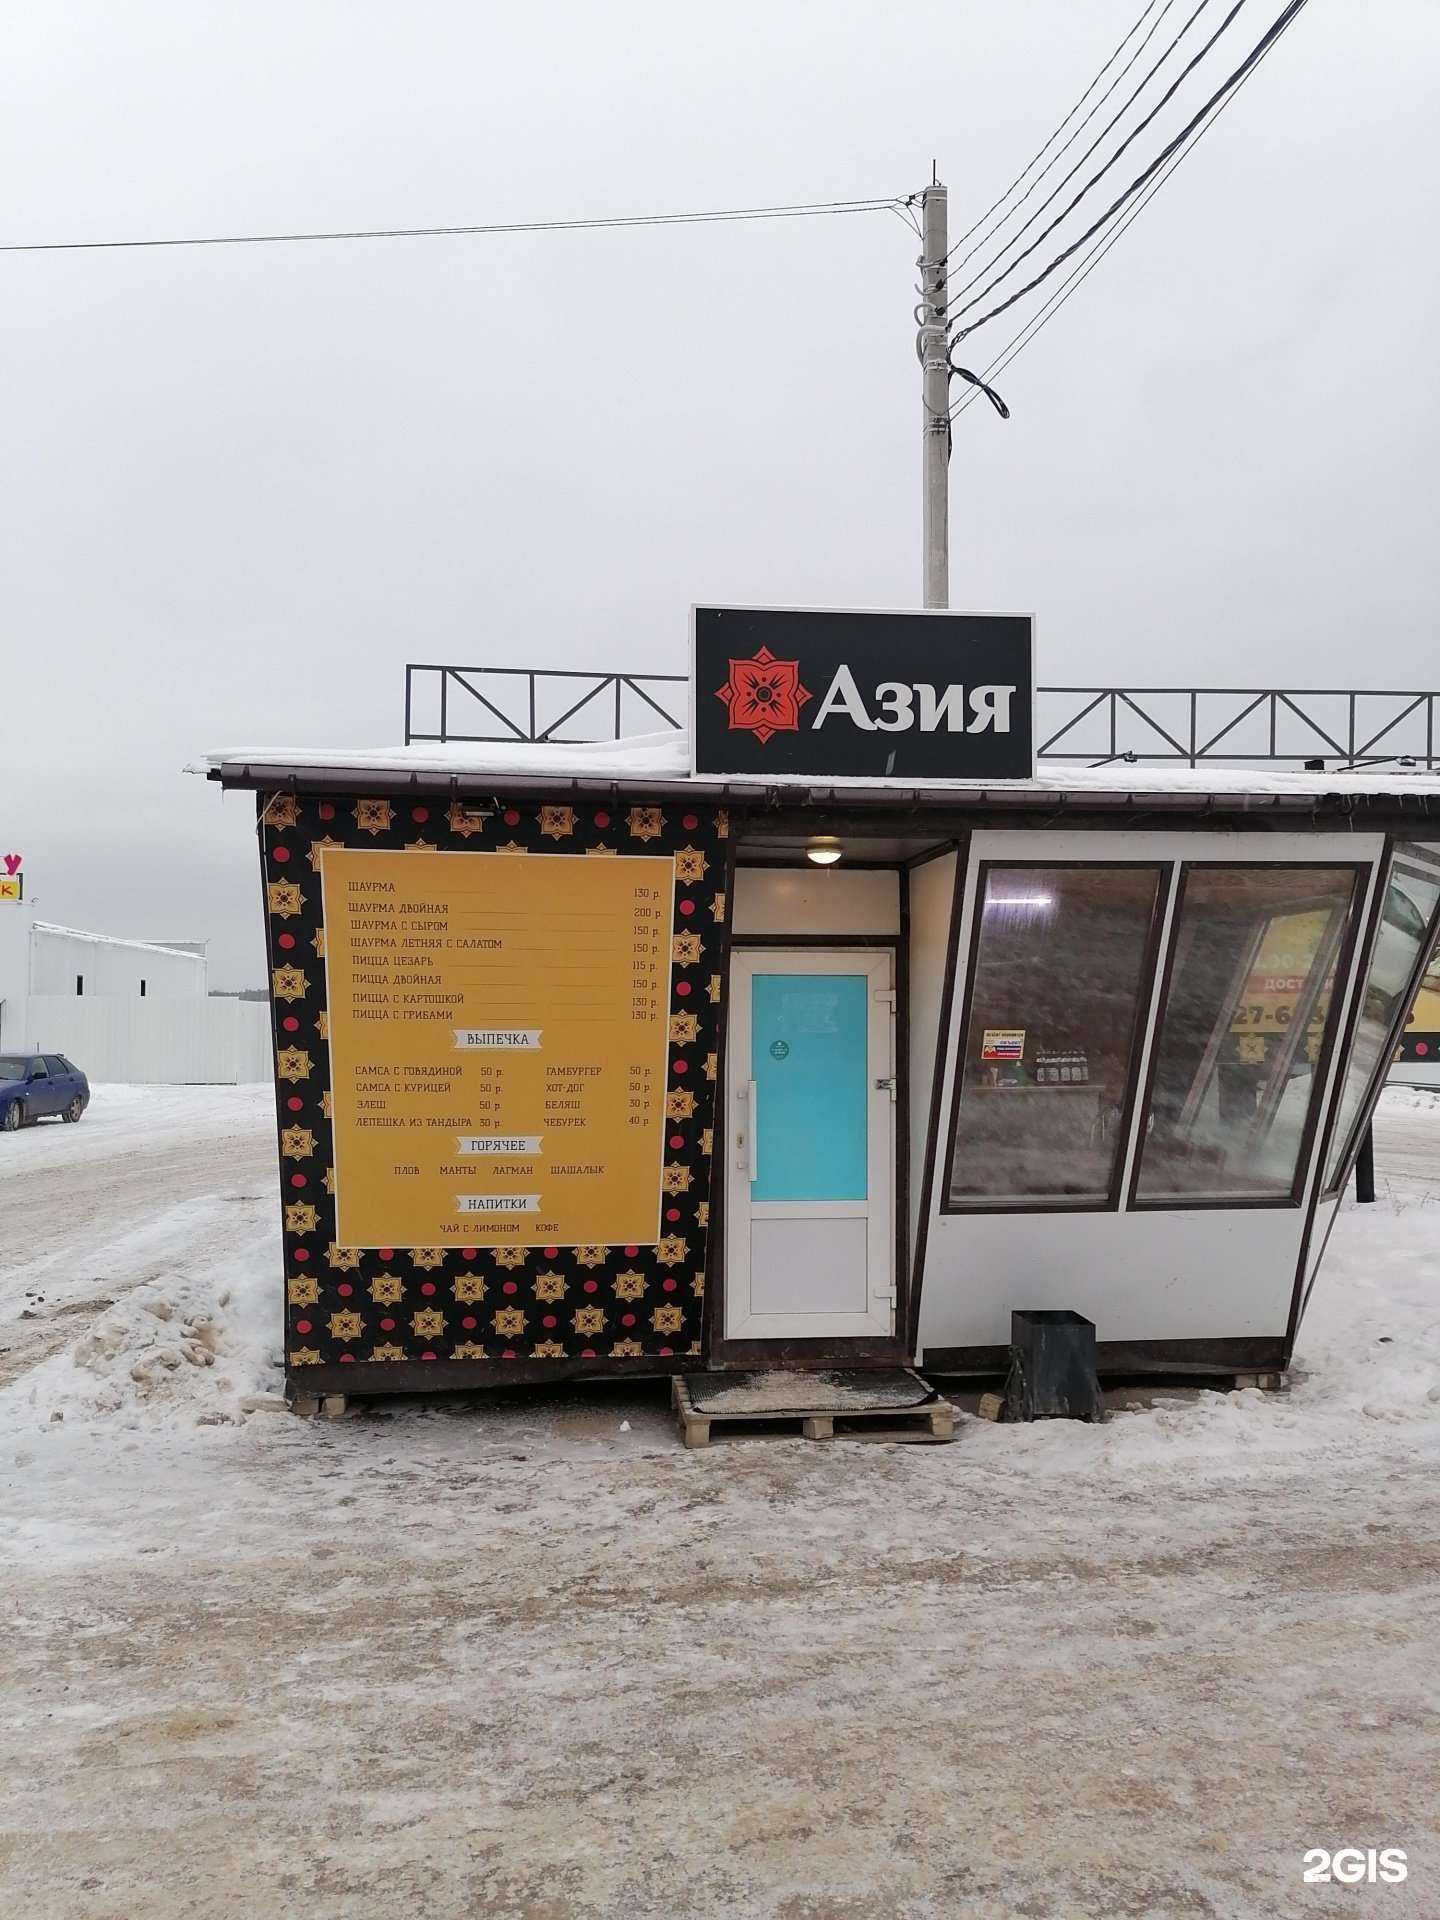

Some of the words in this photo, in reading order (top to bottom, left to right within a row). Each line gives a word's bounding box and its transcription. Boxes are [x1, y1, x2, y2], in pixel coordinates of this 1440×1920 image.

[811, 664, 1017, 734] Азия
[348, 881, 396, 893] ШАУРМА
[348, 902, 395, 913] ШАУРМА
[399, 903, 449, 914] ДВОЙНАЯ
[633, 907, 652, 918] 200
[350, 920, 398, 930] ШАУРМА
[401, 921, 408, 931] С
[411, 921, 448, 931] СЫРОМ
[633, 926, 649, 936] 150
[350, 937, 397, 948] ШАУРМА
[400, 938, 442, 949] ЛЕТНЯЯ
[446, 939, 453, 949] С
[456, 939, 502, 949] САЛАТОМ
[633, 943, 649, 953] 150
[352, 955, 389, 967] ПИЦЦА
[393, 956, 434, 967] ЦЕЗАРЬ
[632, 960, 646, 970] 115
[352, 974, 389, 985] ПИЦЦА
[393, 975, 442, 986] ДВОЙНАЯ
[632, 979, 648, 989] 150
[352, 993, 389, 1004] ПИЦЦА
[393, 994, 400, 1004] С
[403, 993, 464, 1004] КАРТОШКОЙ
[352, 1009, 389, 1020] ПИЦЦА
[393, 1010, 400, 1020] С
[402, 1010, 453, 1020] ГРИБАМИ
[467, 1033, 529, 1045] ВЫПЕЧКА
[355, 1065, 390, 1075] САМСА
[393, 1066, 400, 1075] С
[403, 1066, 462, 1077] ГОВЯДИНОЙ
[480, 1067, 492, 1076] 50
[546, 1066, 602, 1076] ГАМБУРГЕР
[629, 1066, 641, 1075] 50
[355, 1083, 390, 1093] САМСА
[394, 1083, 401, 1092] С
[404, 1083, 451, 1094] КУРИЦЕЙ
[480, 1083, 491, 1093] 50
[545, 1083, 585, 1093] ХОТ-ДОГ
[629, 1082, 641, 1091] 50
[479, 1100, 490, 1110] 50
[545, 1100, 581, 1110] БЕЛЯШ
[356, 1117, 406, 1127] ЛЕПЕШКА
[409, 1117, 422, 1127] ИЗ
[425, 1117, 472, 1128] ТАНДЫРА
[543, 1117, 587, 1127] ЧЕБУРЕК
[628, 1116, 640, 1125] 40
[471, 1140, 526, 1151] ГОРЯЧЕЕ
[394, 1166, 420, 1175] ПЛОВ
[439, 1166, 477, 1175] МАНТЫ
[492, 1166, 534, 1175] ЛАГМАН
[550, 1165, 605, 1175] ШАШАЛЫК
[468, 1199, 527, 1210] НАПИТКИ
[440, 1223, 460, 1233] ЧАЙ
[462, 1224, 469, 1233] С
[473, 1223, 520, 1233] ЛИМОНОМ
[535, 1223, 559, 1233] КОФЕ
